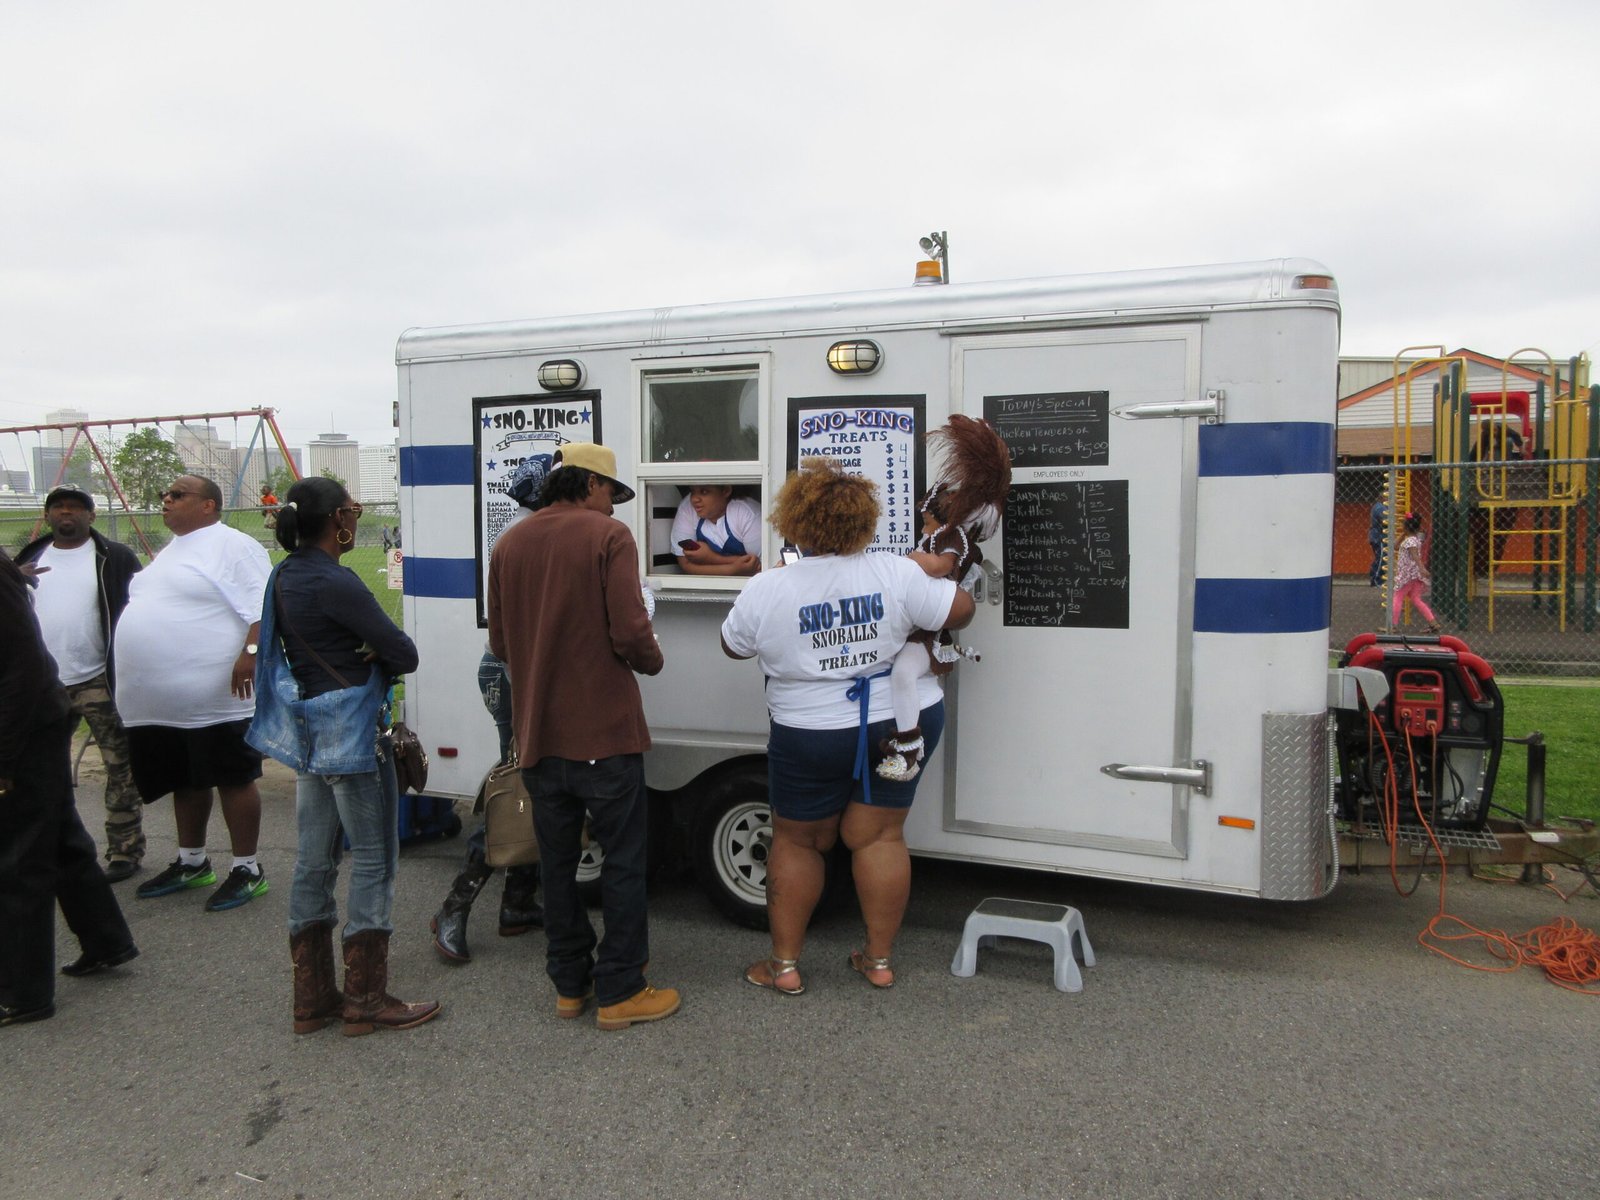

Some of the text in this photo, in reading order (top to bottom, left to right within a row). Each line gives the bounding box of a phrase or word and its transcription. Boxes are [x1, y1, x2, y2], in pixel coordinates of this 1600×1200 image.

[493, 408, 579, 431] SNO-KING
[801, 409, 913, 439] SNO-KING
[829, 431, 888, 443] TREATS
[800, 445, 862, 457] NACHOS
[886, 443, 893, 454] $
[886, 457, 894, 468] $
[886, 470, 894, 480] $
[902, 470, 909, 479] 1
[887, 483, 909, 493] $ 1
[887, 497, 909, 506] $ 1
[888, 509, 910, 517] $ 1
[889, 522, 910, 532] $ 1
[889, 534, 909, 544] $1.25
[798, 592, 885, 635] SNO-KING
[812, 622, 879, 649] SNOBALLS
[840, 644, 851, 655] &
[819, 650, 879, 672] TREATS
